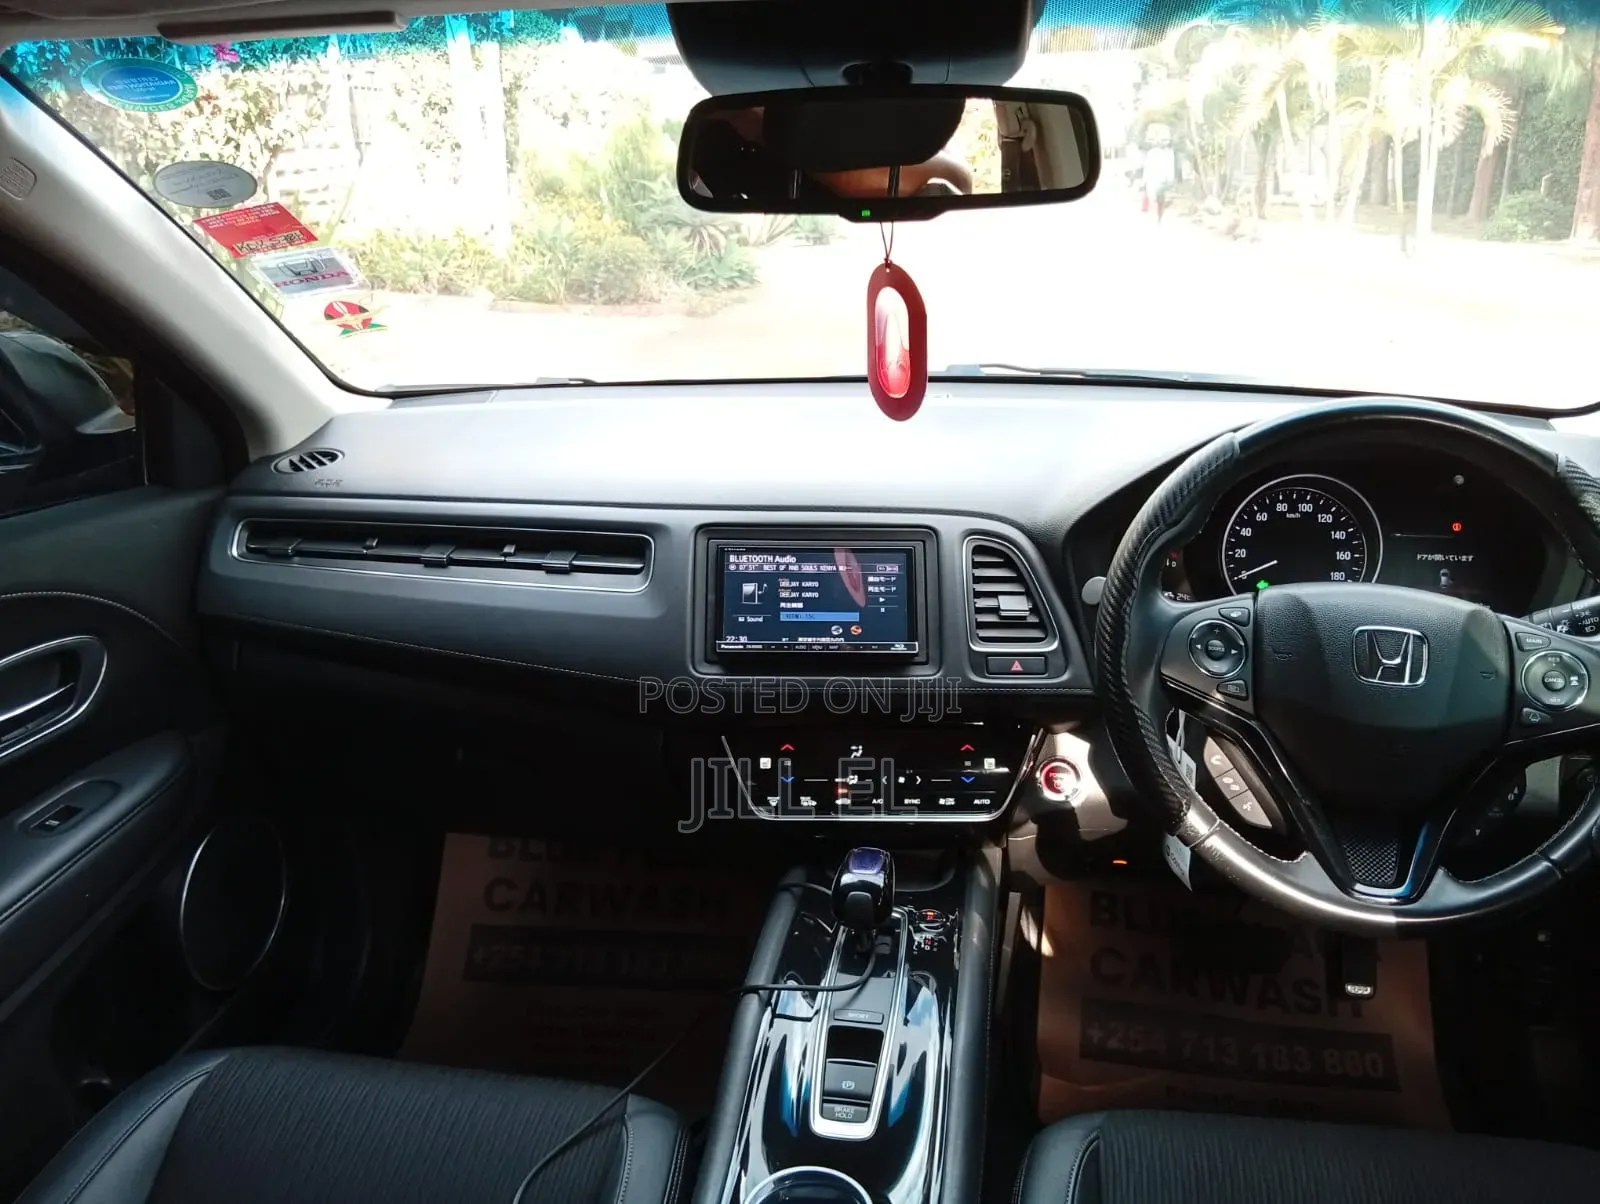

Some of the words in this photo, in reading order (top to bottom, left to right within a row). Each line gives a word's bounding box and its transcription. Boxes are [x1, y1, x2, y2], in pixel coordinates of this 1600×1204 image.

[273, 270, 349, 288] HONDA
[1276, 503, 1288, 512] 80
[1298, 503, 1313, 512] 100
[1256, 512, 1268, 521] 60
[1318, 514, 1333, 523] 120
[1240, 527, 1252, 536] 40
[1331, 531, 1346, 540] 140
[1235, 549, 1246, 558] 20
[1336, 551, 1351, 560] 160
[729, 555, 773, 563] BLUETOOTH
[774, 555, 797, 563] Audio
[1330, 571, 1346, 581] 180
